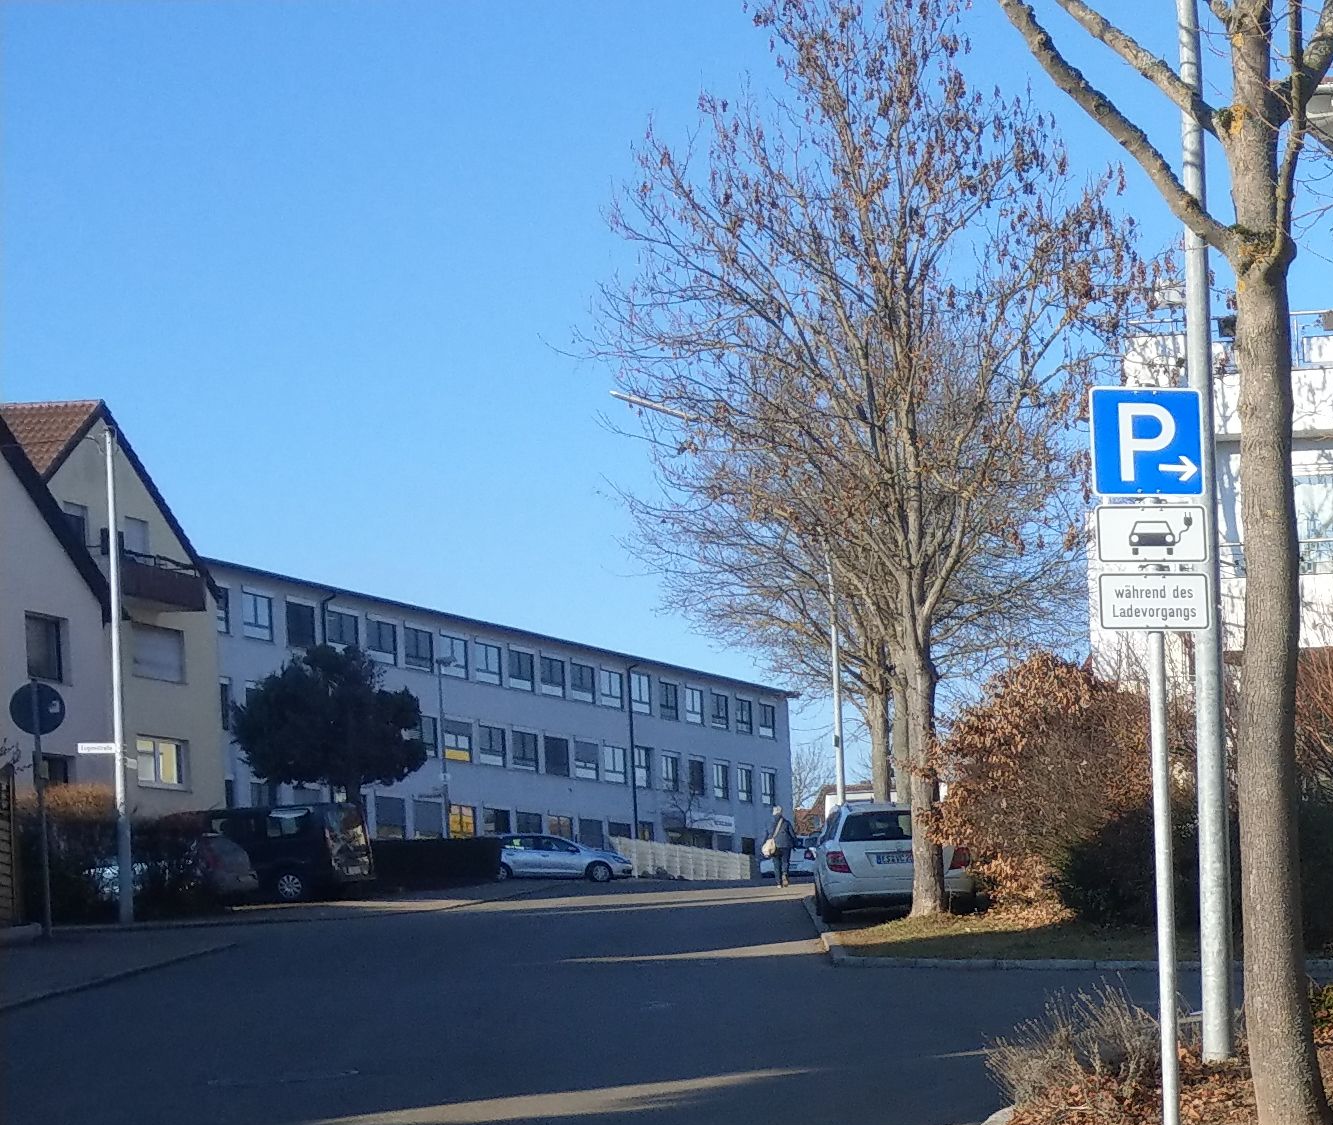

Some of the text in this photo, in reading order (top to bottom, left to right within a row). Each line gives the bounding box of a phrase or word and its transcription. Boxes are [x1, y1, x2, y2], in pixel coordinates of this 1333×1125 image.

[1117, 402, 1176, 482] P
[1114, 584, 1194, 599] während des
[1112, 604, 1197, 621] Ladevorgangs
